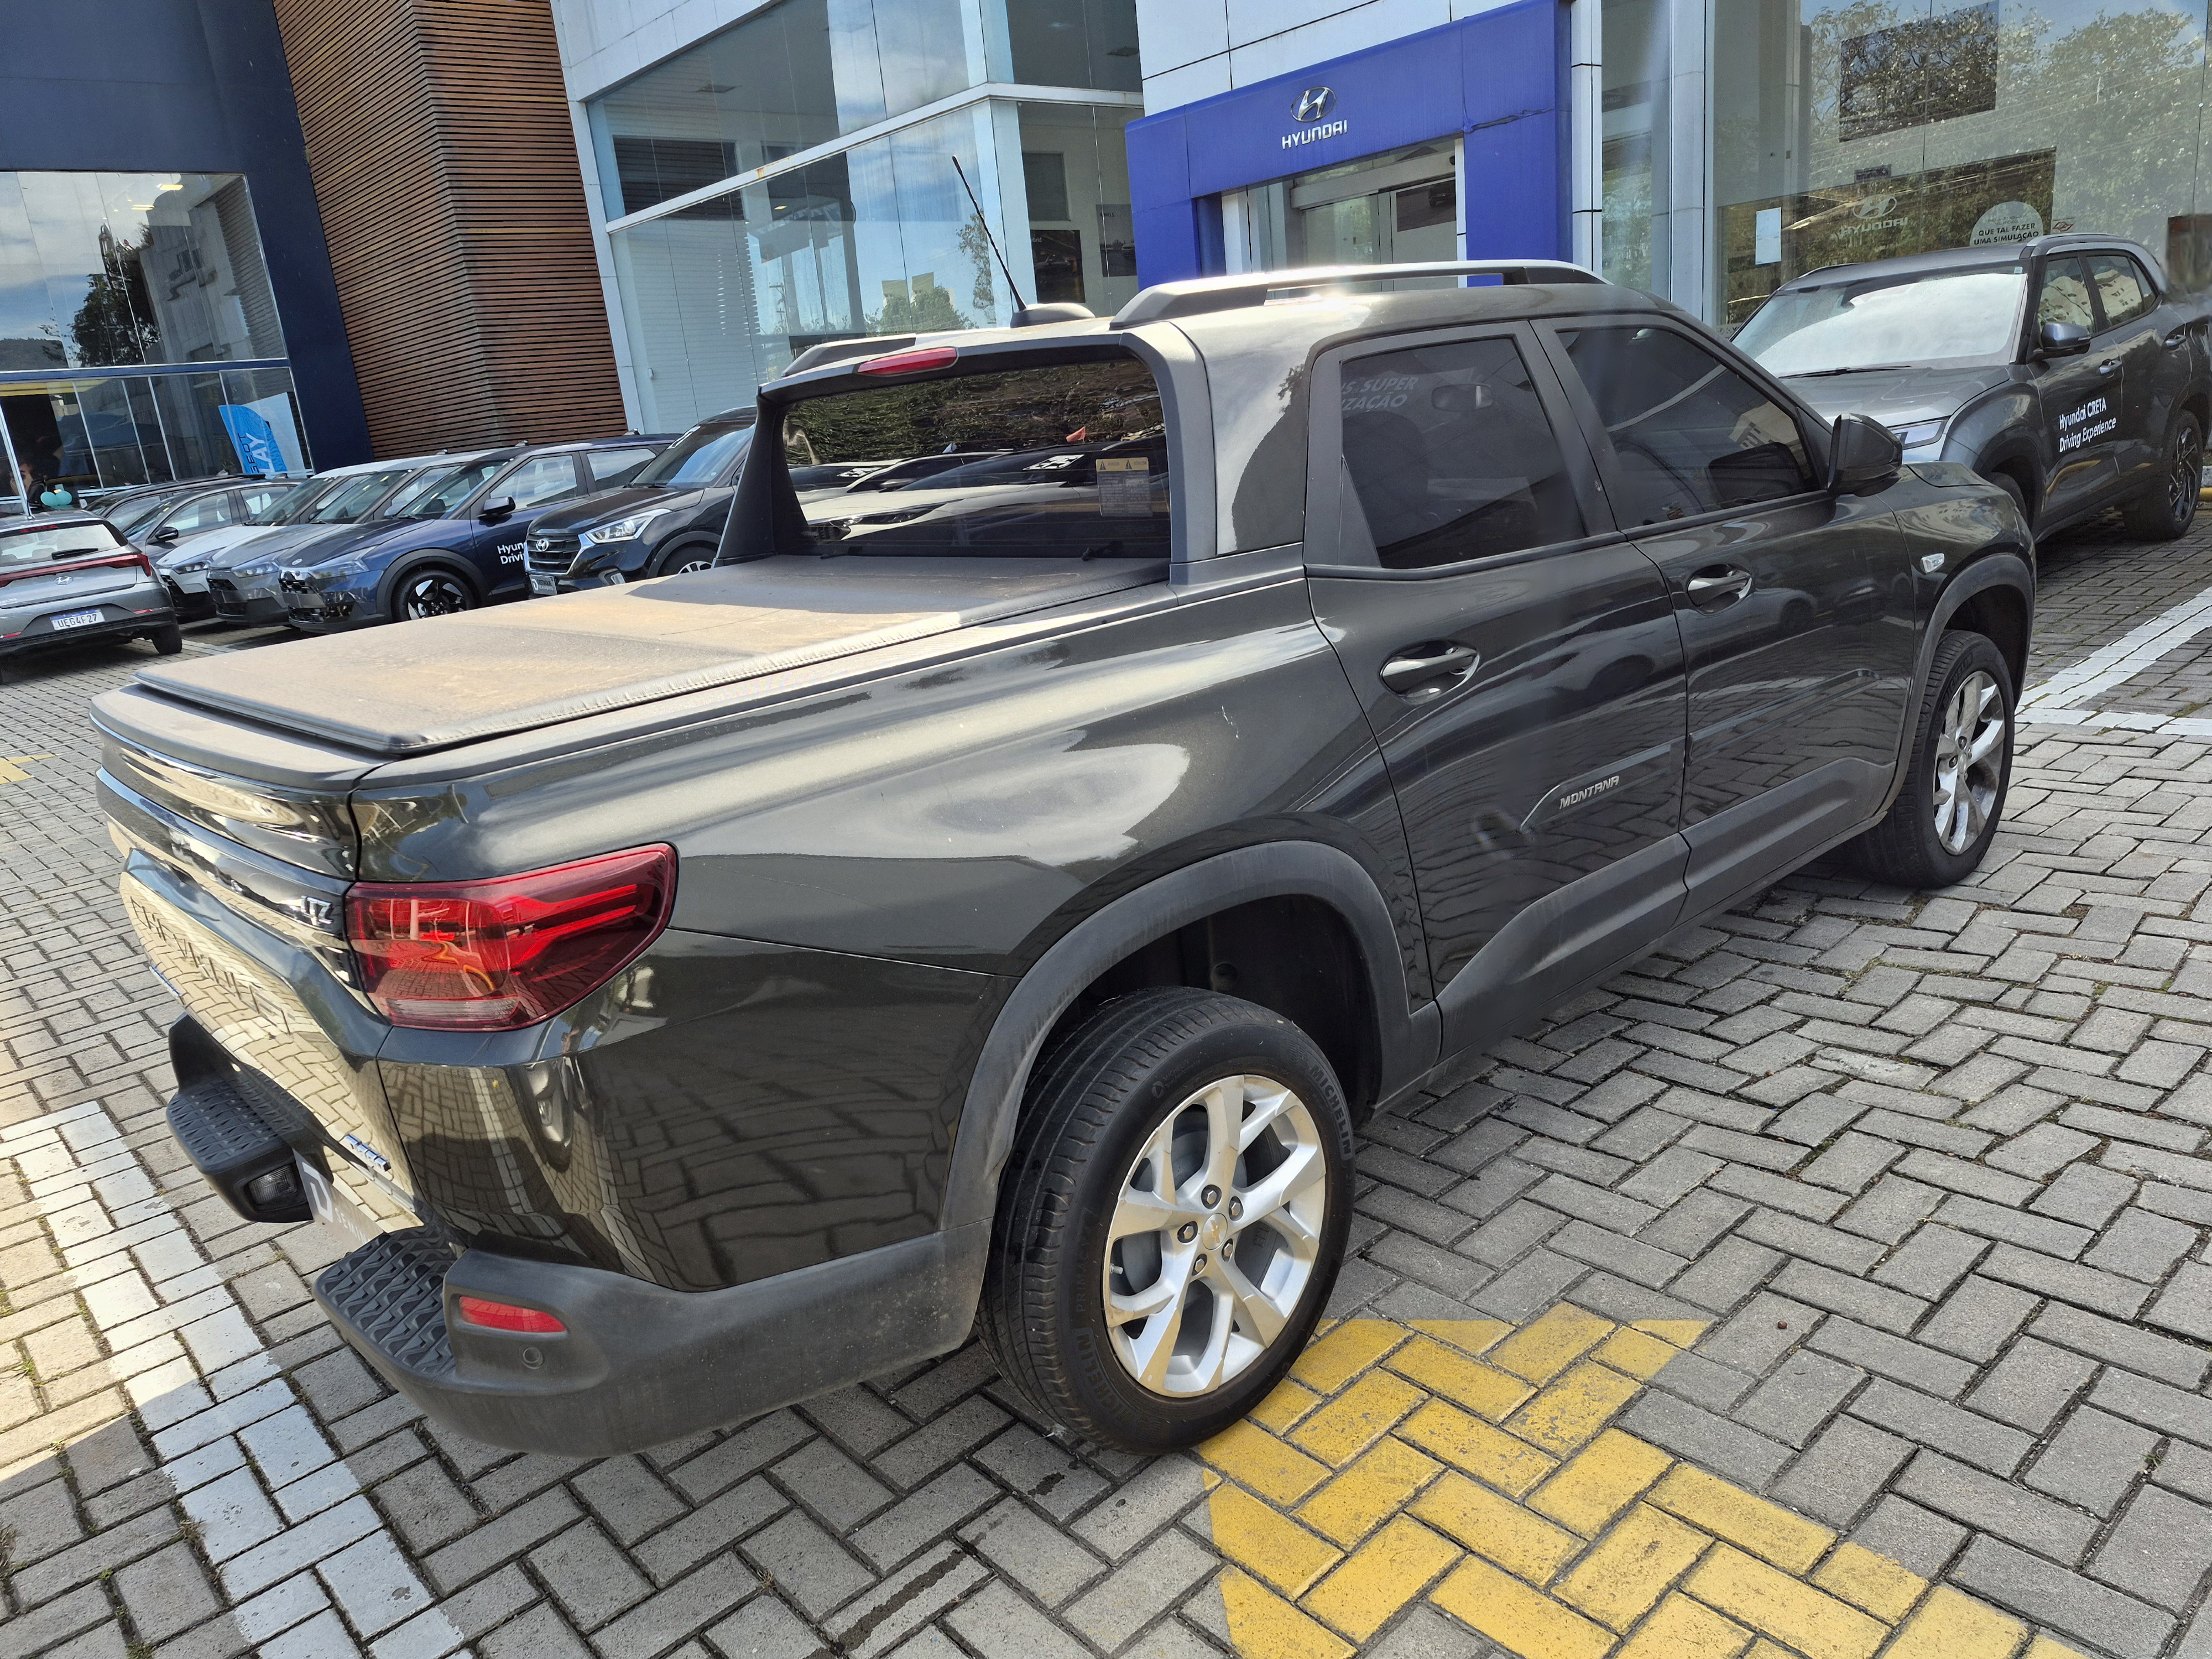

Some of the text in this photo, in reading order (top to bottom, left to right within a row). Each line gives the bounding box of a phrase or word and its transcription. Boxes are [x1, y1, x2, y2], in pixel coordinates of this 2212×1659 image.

[1281, 119, 1348, 150] HYUNDAI
[1840, 217, 1908, 237] HYUNDAI
[2012, 223, 2036, 231] FAZER
[1359, 377, 1419, 393] SUPER
[2059, 397, 2107, 431] Hyundai CRETA
[2059, 417, 2116, 453] Driving Experience
[246, 432, 276, 474] LAY
[497, 542, 525, 555] Hyun
[500, 551, 525, 564] Drivi
[58, 613, 97, 628] UEG4F27
[1559, 775, 1620, 810] MONTANA
[300, 895, 333, 927] LTZ
[1308, 1063, 1352, 1155] MICHELIN
[335, 1207, 371, 1245] SEMIN
